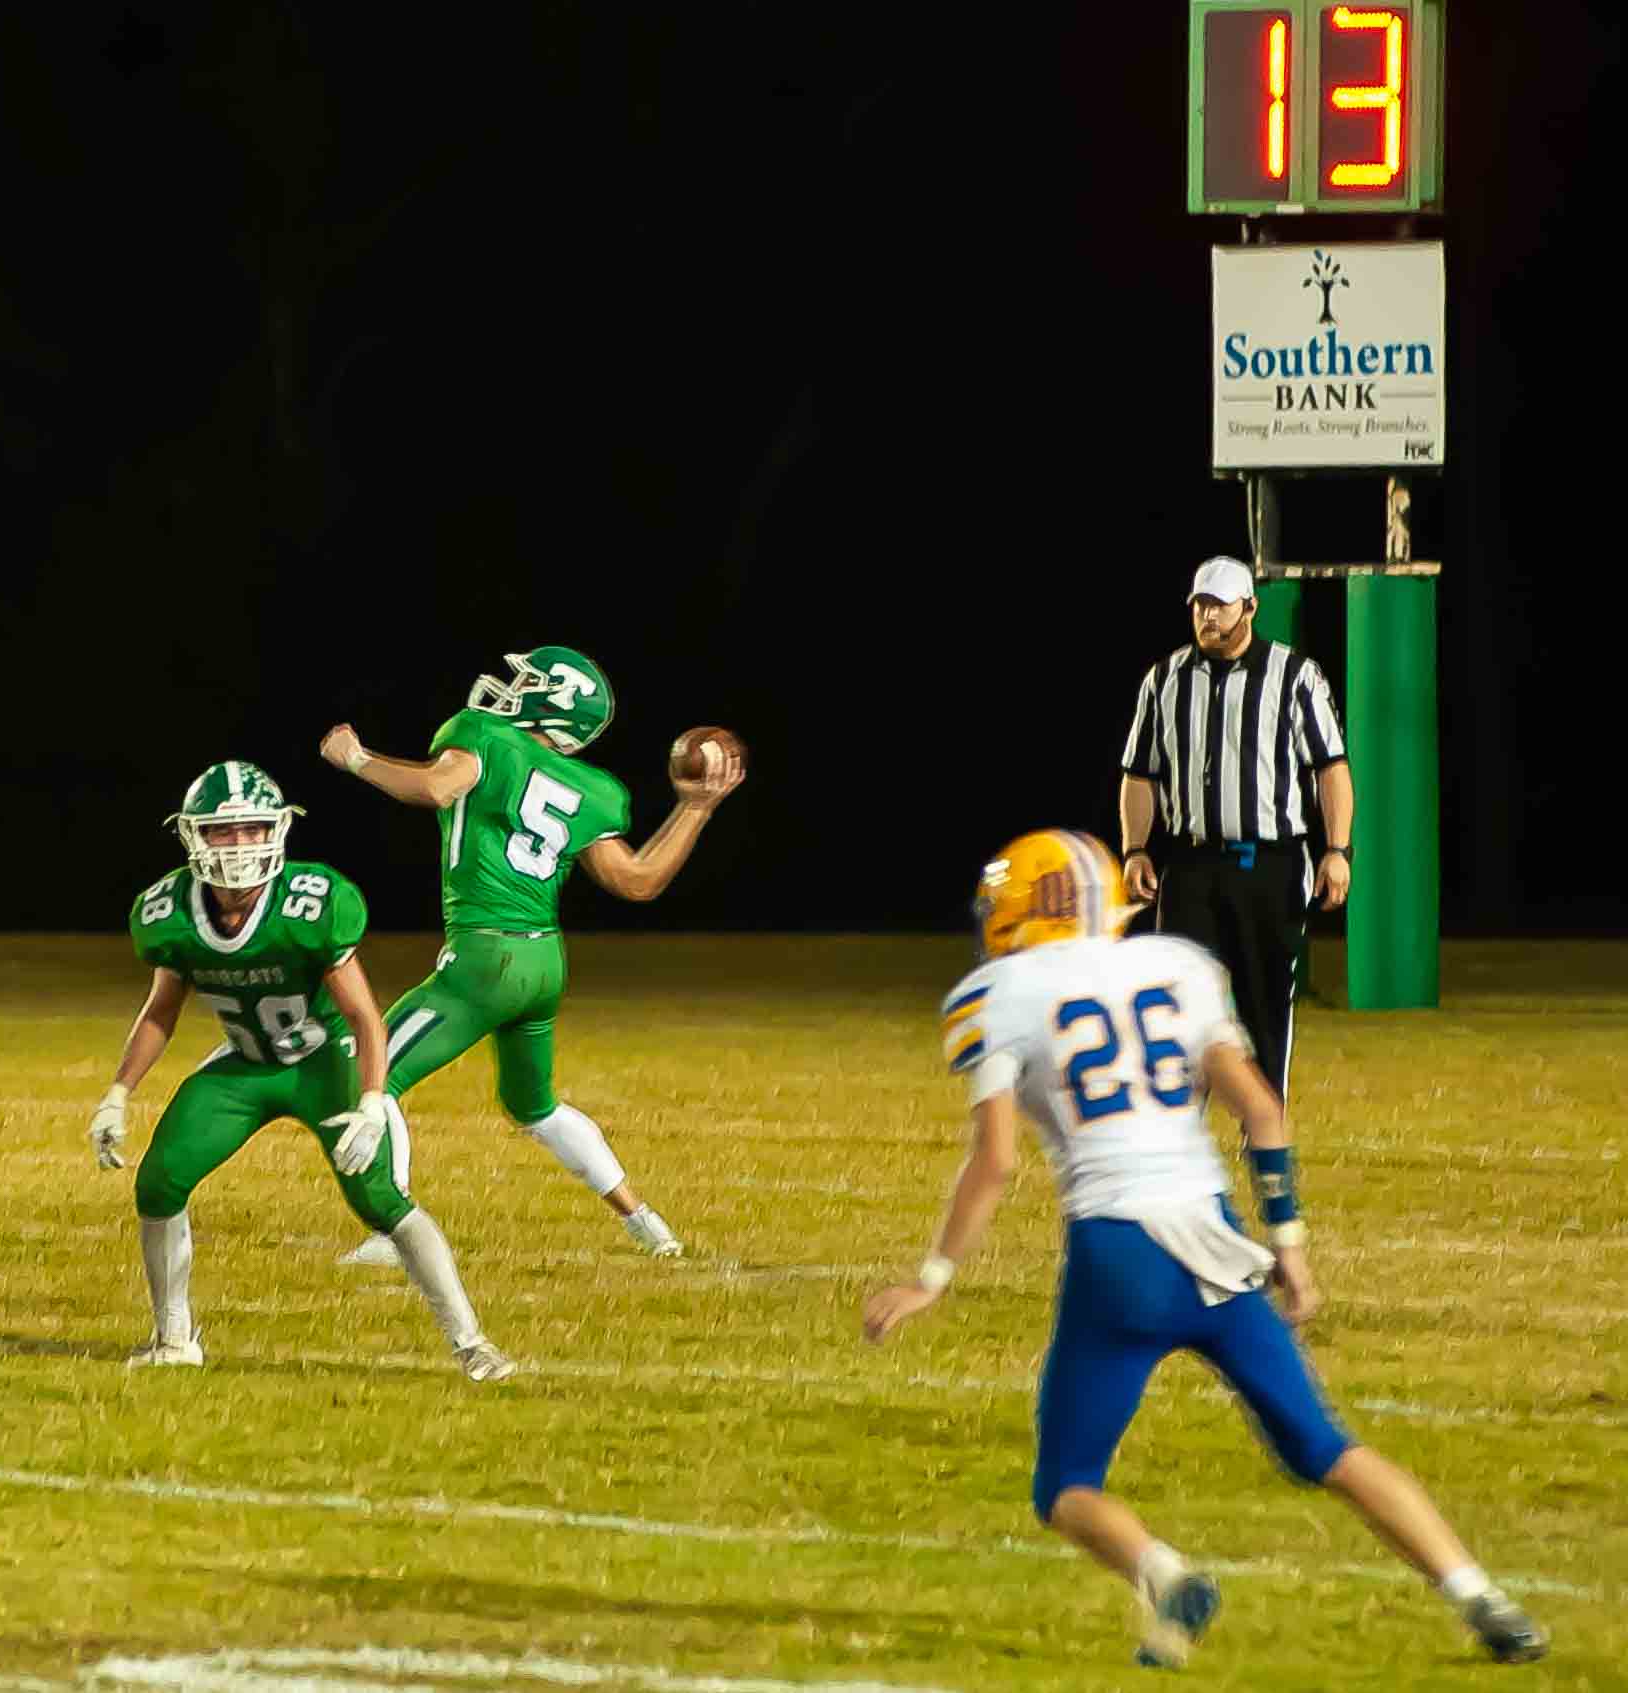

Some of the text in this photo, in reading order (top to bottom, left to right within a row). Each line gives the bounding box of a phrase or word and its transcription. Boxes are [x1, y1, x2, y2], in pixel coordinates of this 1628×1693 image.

[1267, 7, 1402, 186] 13
[1223, 328, 1434, 378] Southern
[1276, 383, 1377, 412] BANK
[548, 662, 597, 710] T
[505, 768, 583, 881] 5
[281, 873, 330, 923] 58
[1057, 984, 1195, 1123] 26
